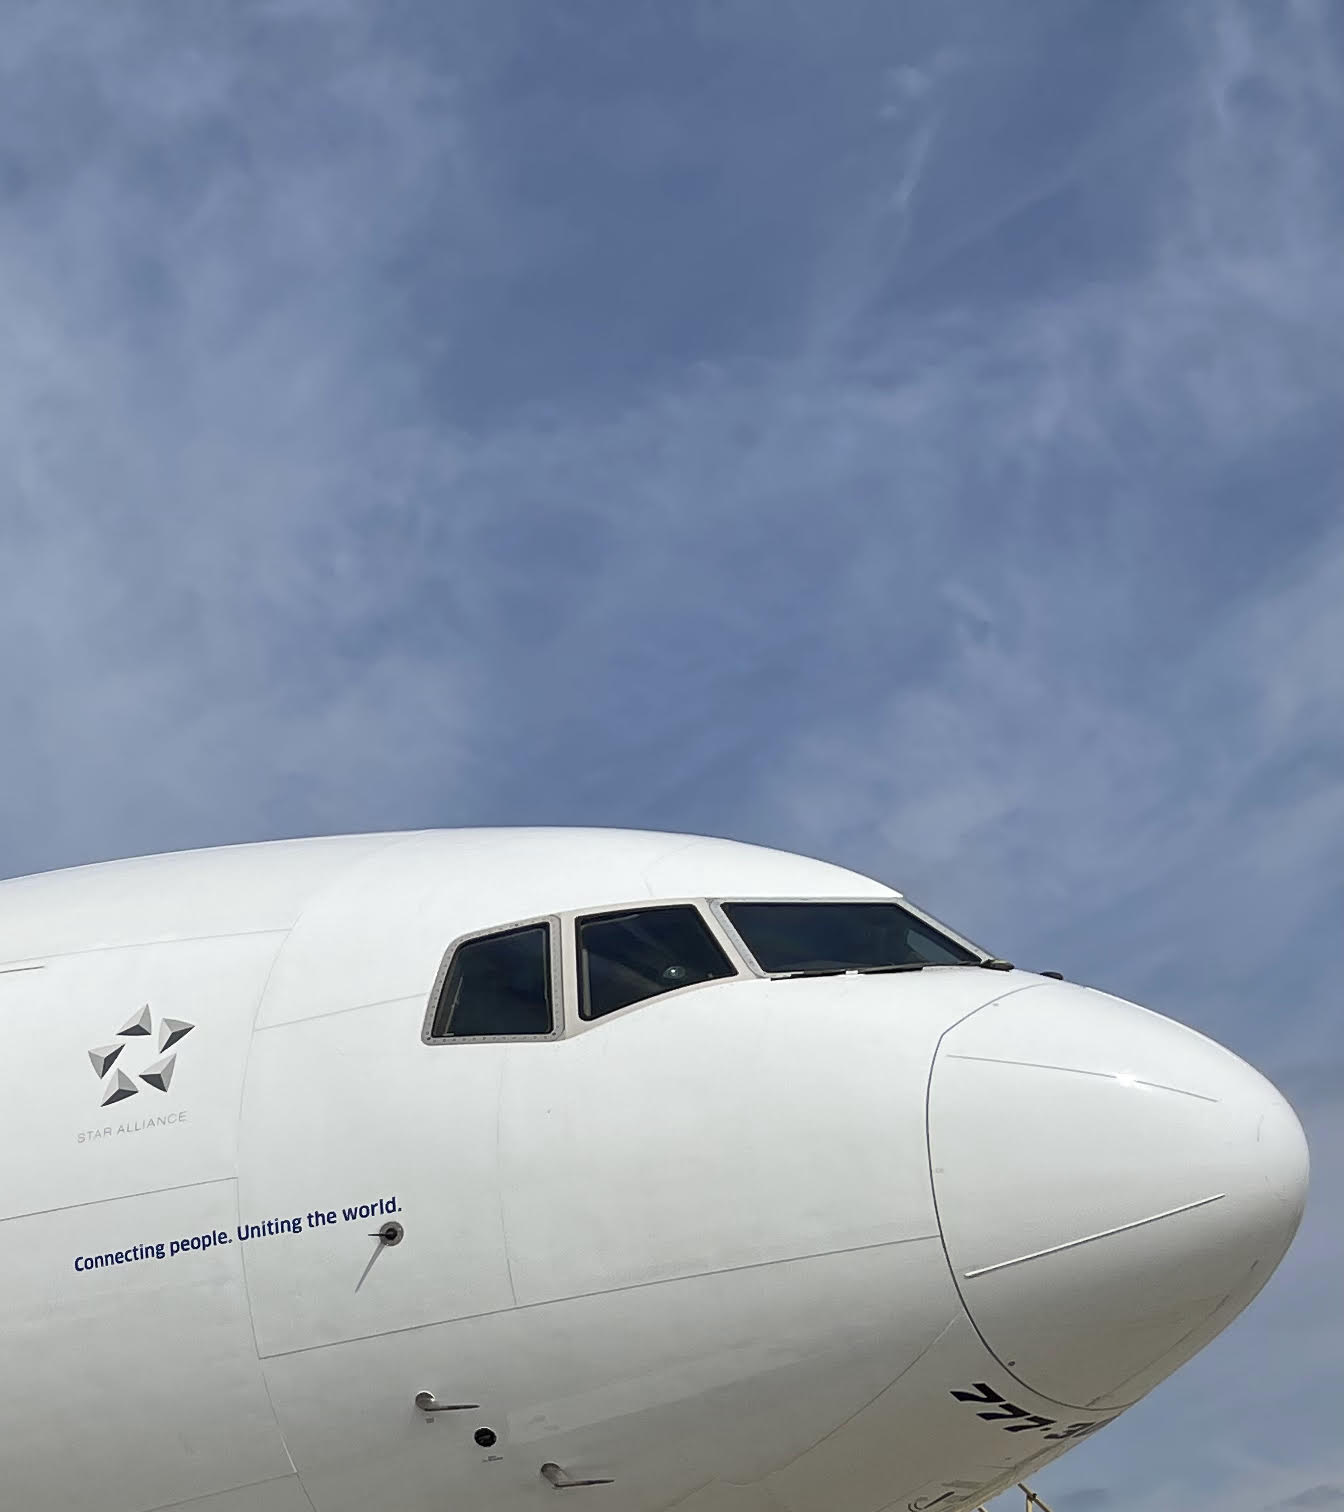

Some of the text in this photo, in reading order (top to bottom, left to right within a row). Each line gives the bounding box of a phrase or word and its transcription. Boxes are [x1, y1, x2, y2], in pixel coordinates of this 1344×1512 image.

[77, 1110, 188, 1144] STAR ALLIANCE
[74, 1196, 403, 1272] Connecting people. Uniting the world.
